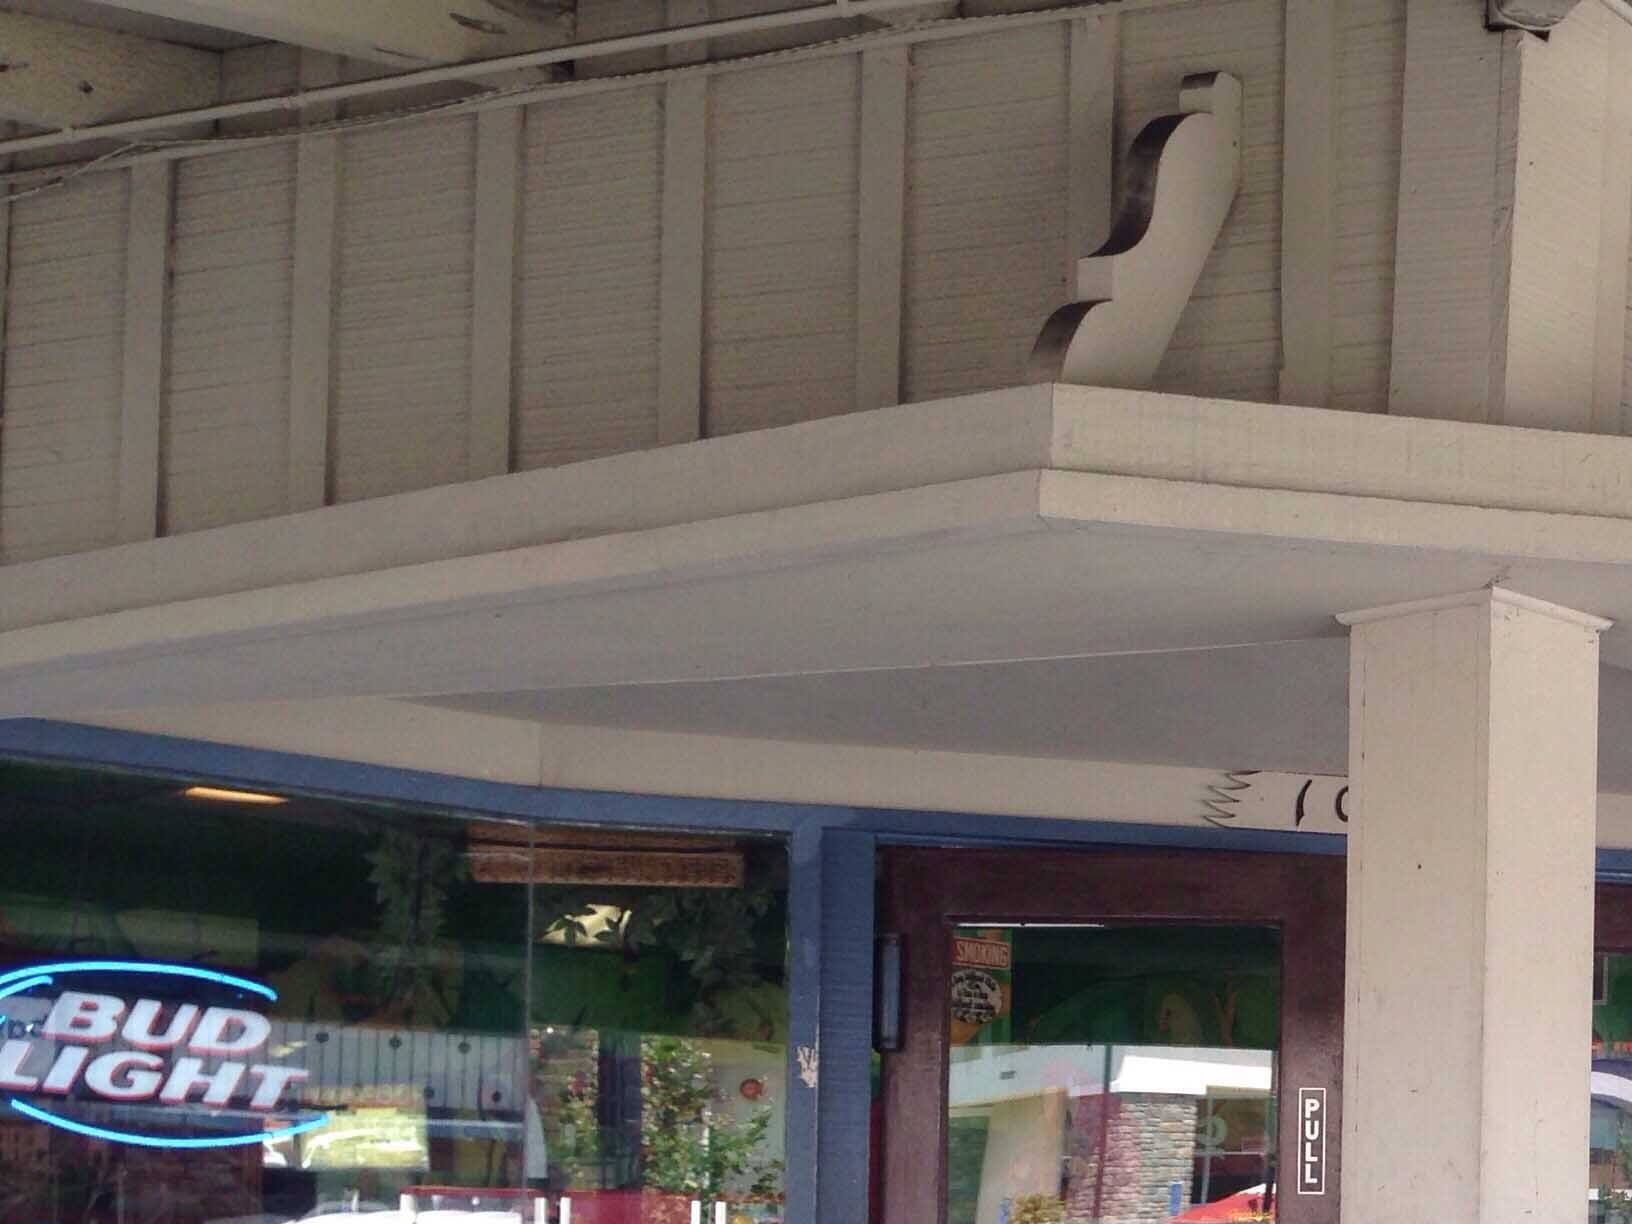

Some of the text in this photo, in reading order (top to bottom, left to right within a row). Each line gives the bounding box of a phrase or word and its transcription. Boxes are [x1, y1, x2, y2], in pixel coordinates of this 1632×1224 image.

[42, 990, 272, 1055] BUD
[0, 1040, 309, 1110] LIGHT
[1304, 1098, 1321, 1184] PULL
